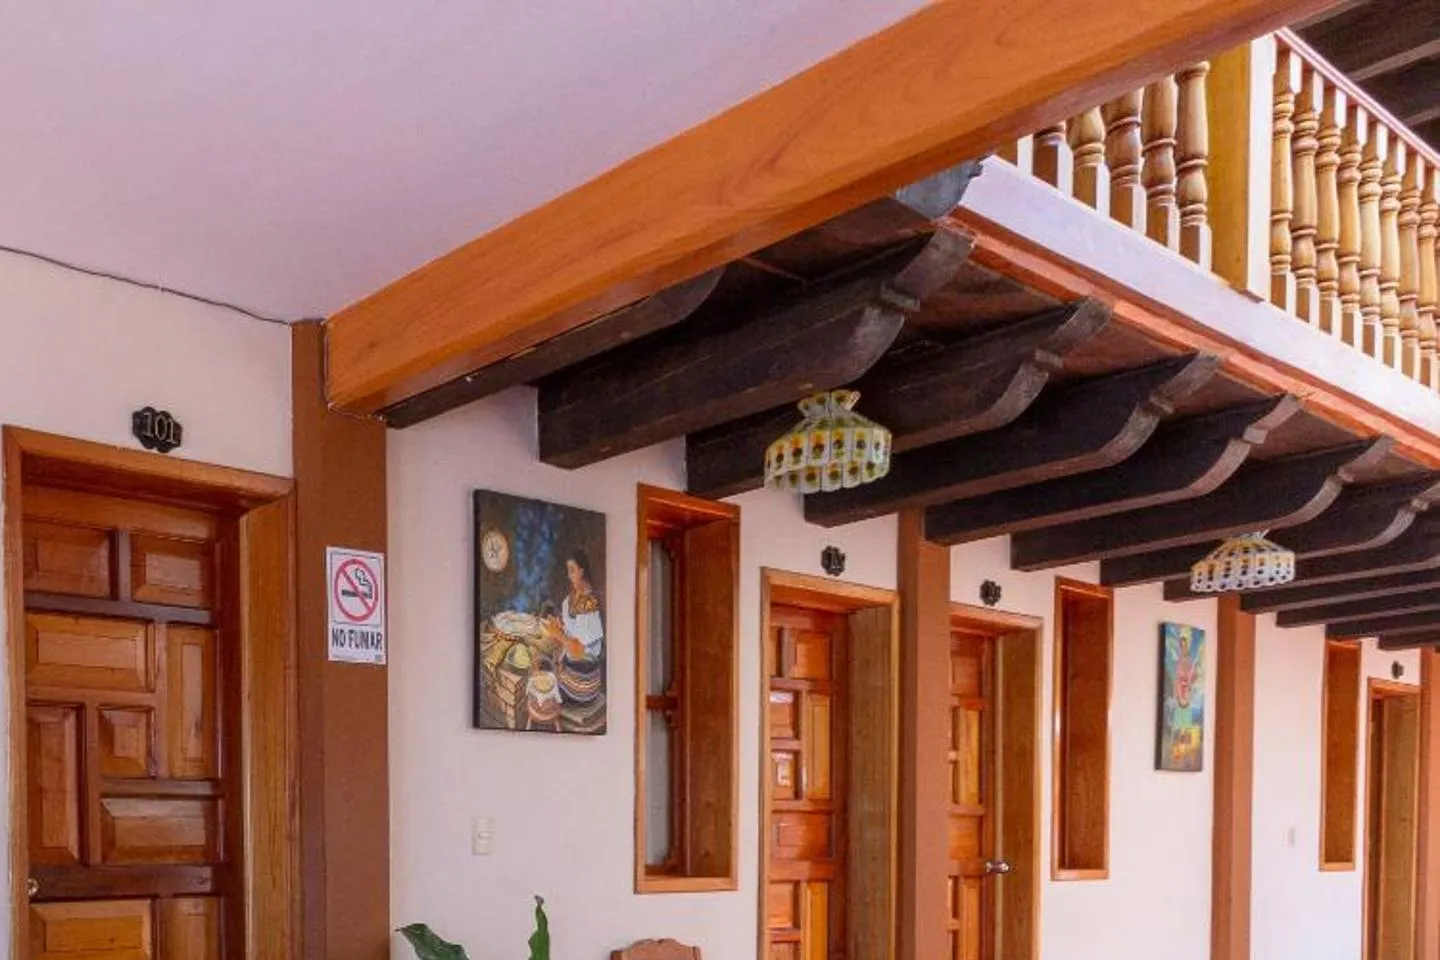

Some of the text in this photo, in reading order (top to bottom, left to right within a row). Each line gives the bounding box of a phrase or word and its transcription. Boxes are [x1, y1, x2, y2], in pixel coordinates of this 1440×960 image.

[141, 412, 176, 444] 101
[331, 628, 383, 652] NO FUMAR
